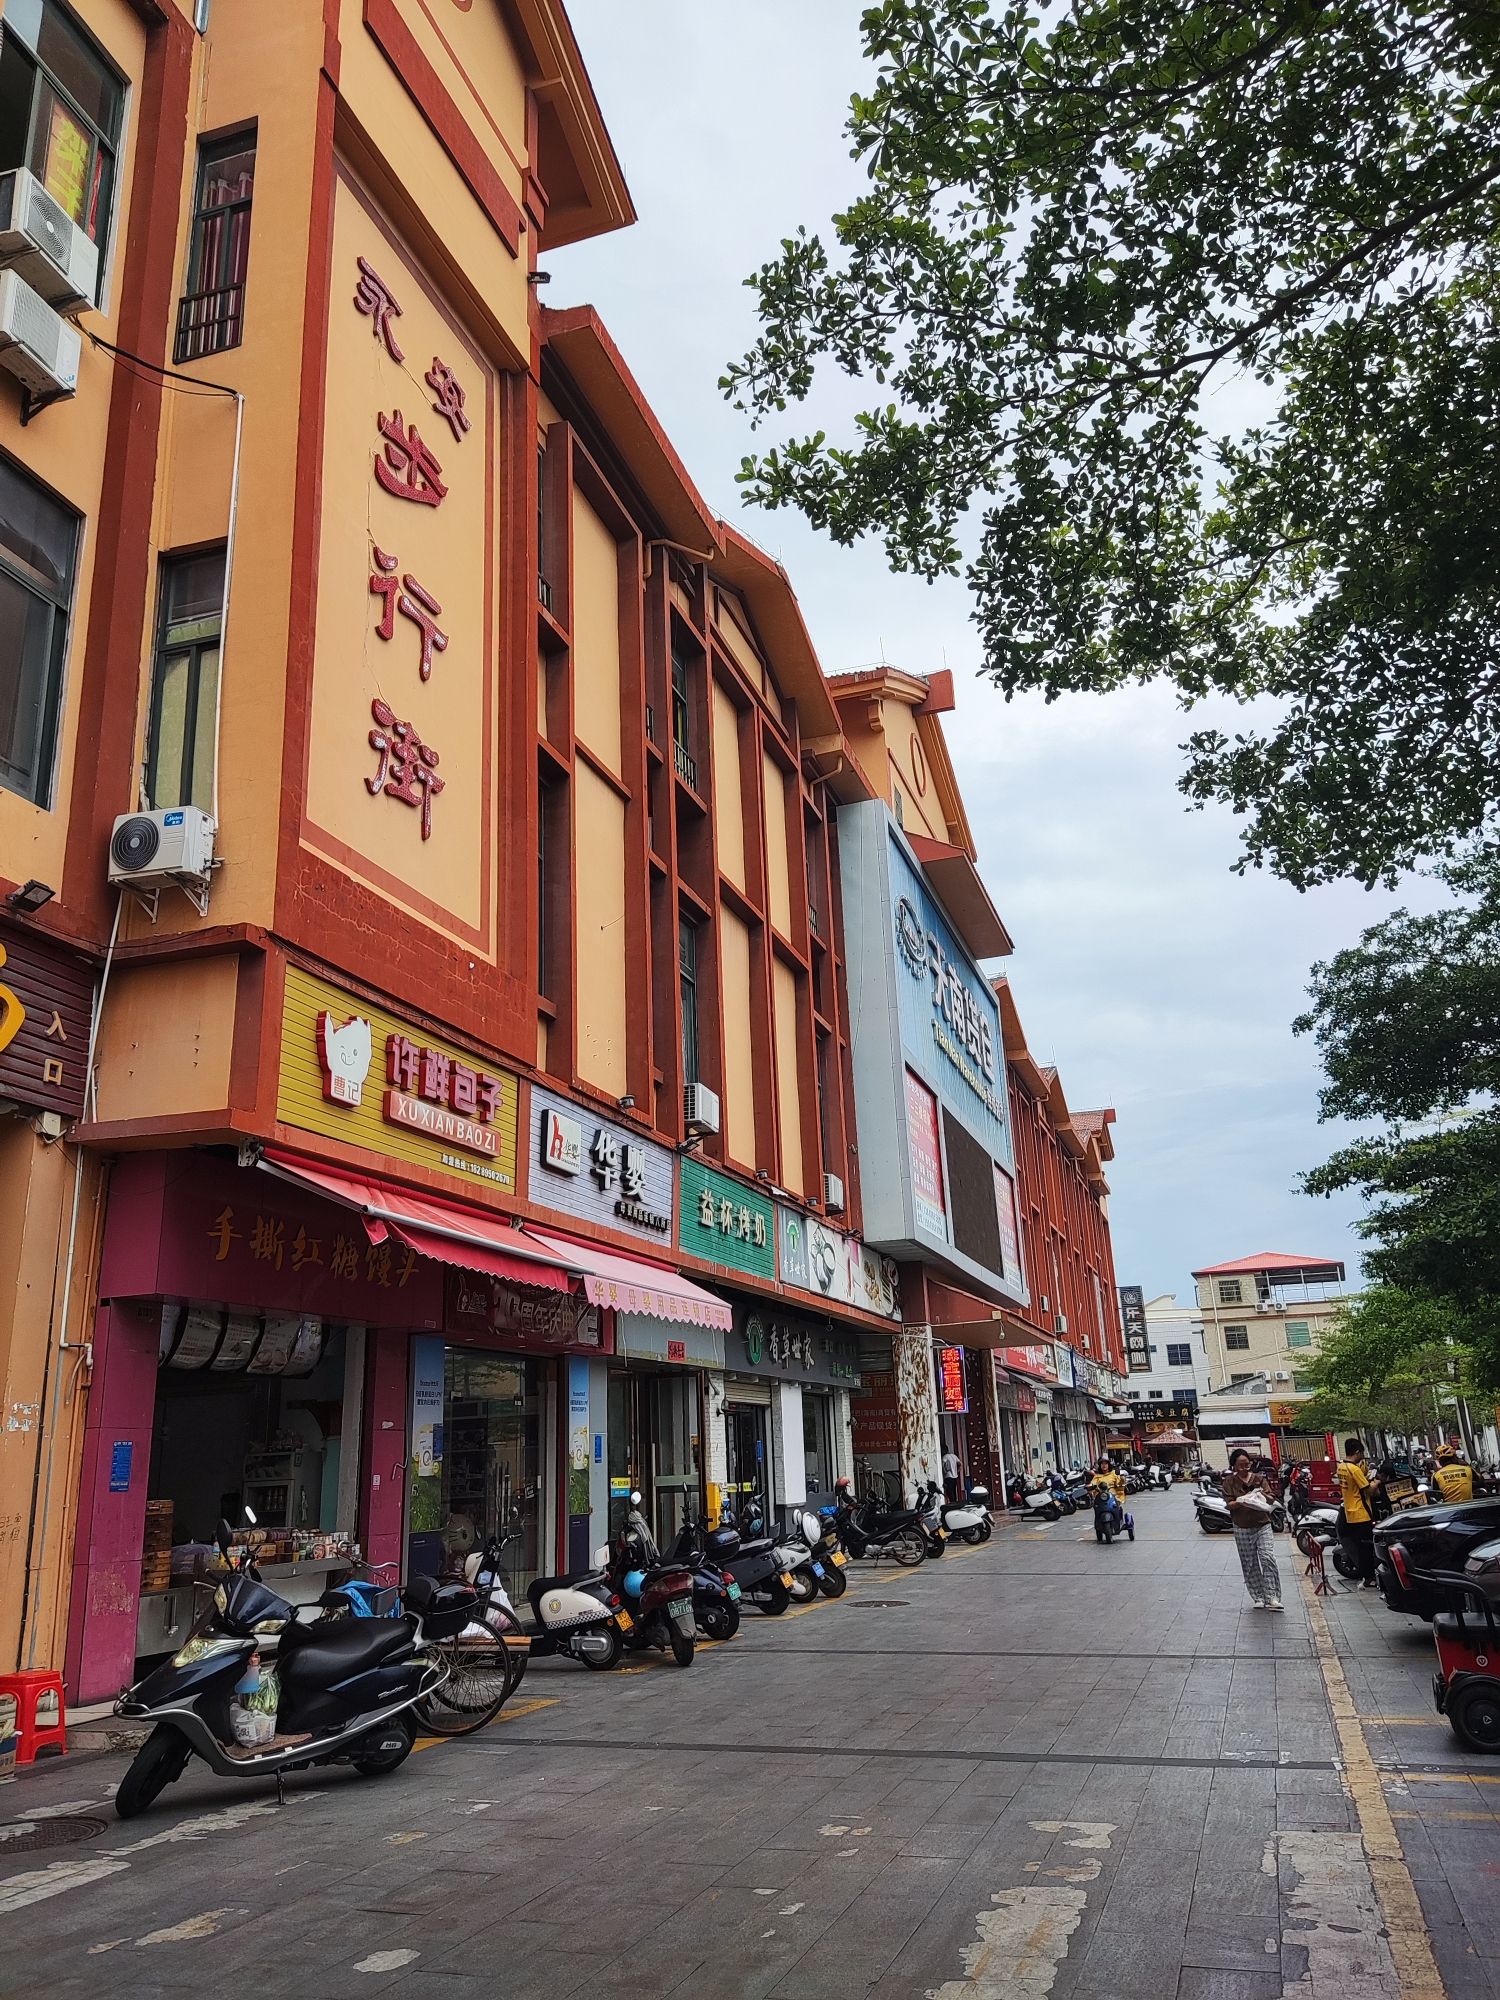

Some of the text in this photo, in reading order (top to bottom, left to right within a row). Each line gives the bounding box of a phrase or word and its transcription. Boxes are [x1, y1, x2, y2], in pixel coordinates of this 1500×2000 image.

[364, 409, 449, 841] 步行街
[44, 1010, 67, 1086] 入口
[334, 1075, 360, 1103] 曹记
[386, 1033, 504, 1123] 许鲜包子
[398, 1098, 497, 1151] XU XIAN BAO ZI
[591, 1129, 647, 1201] 华婴
[206, 1204, 420, 1288] 手撕红糖馒头
[699, 1188, 766, 1248] 益杯烤奶
[593, 1280, 618, 1303] 华婴
[628, 1288, 712, 1322] 母婴用品连锁店
[769, 1323, 815, 1370] 香草世家
[1126, 1307, 1147, 1364] 乐天网咖
[945, 1400, 964, 1411] 二楼
[1156, 1408, 1189, 1418] 臭豆腐
